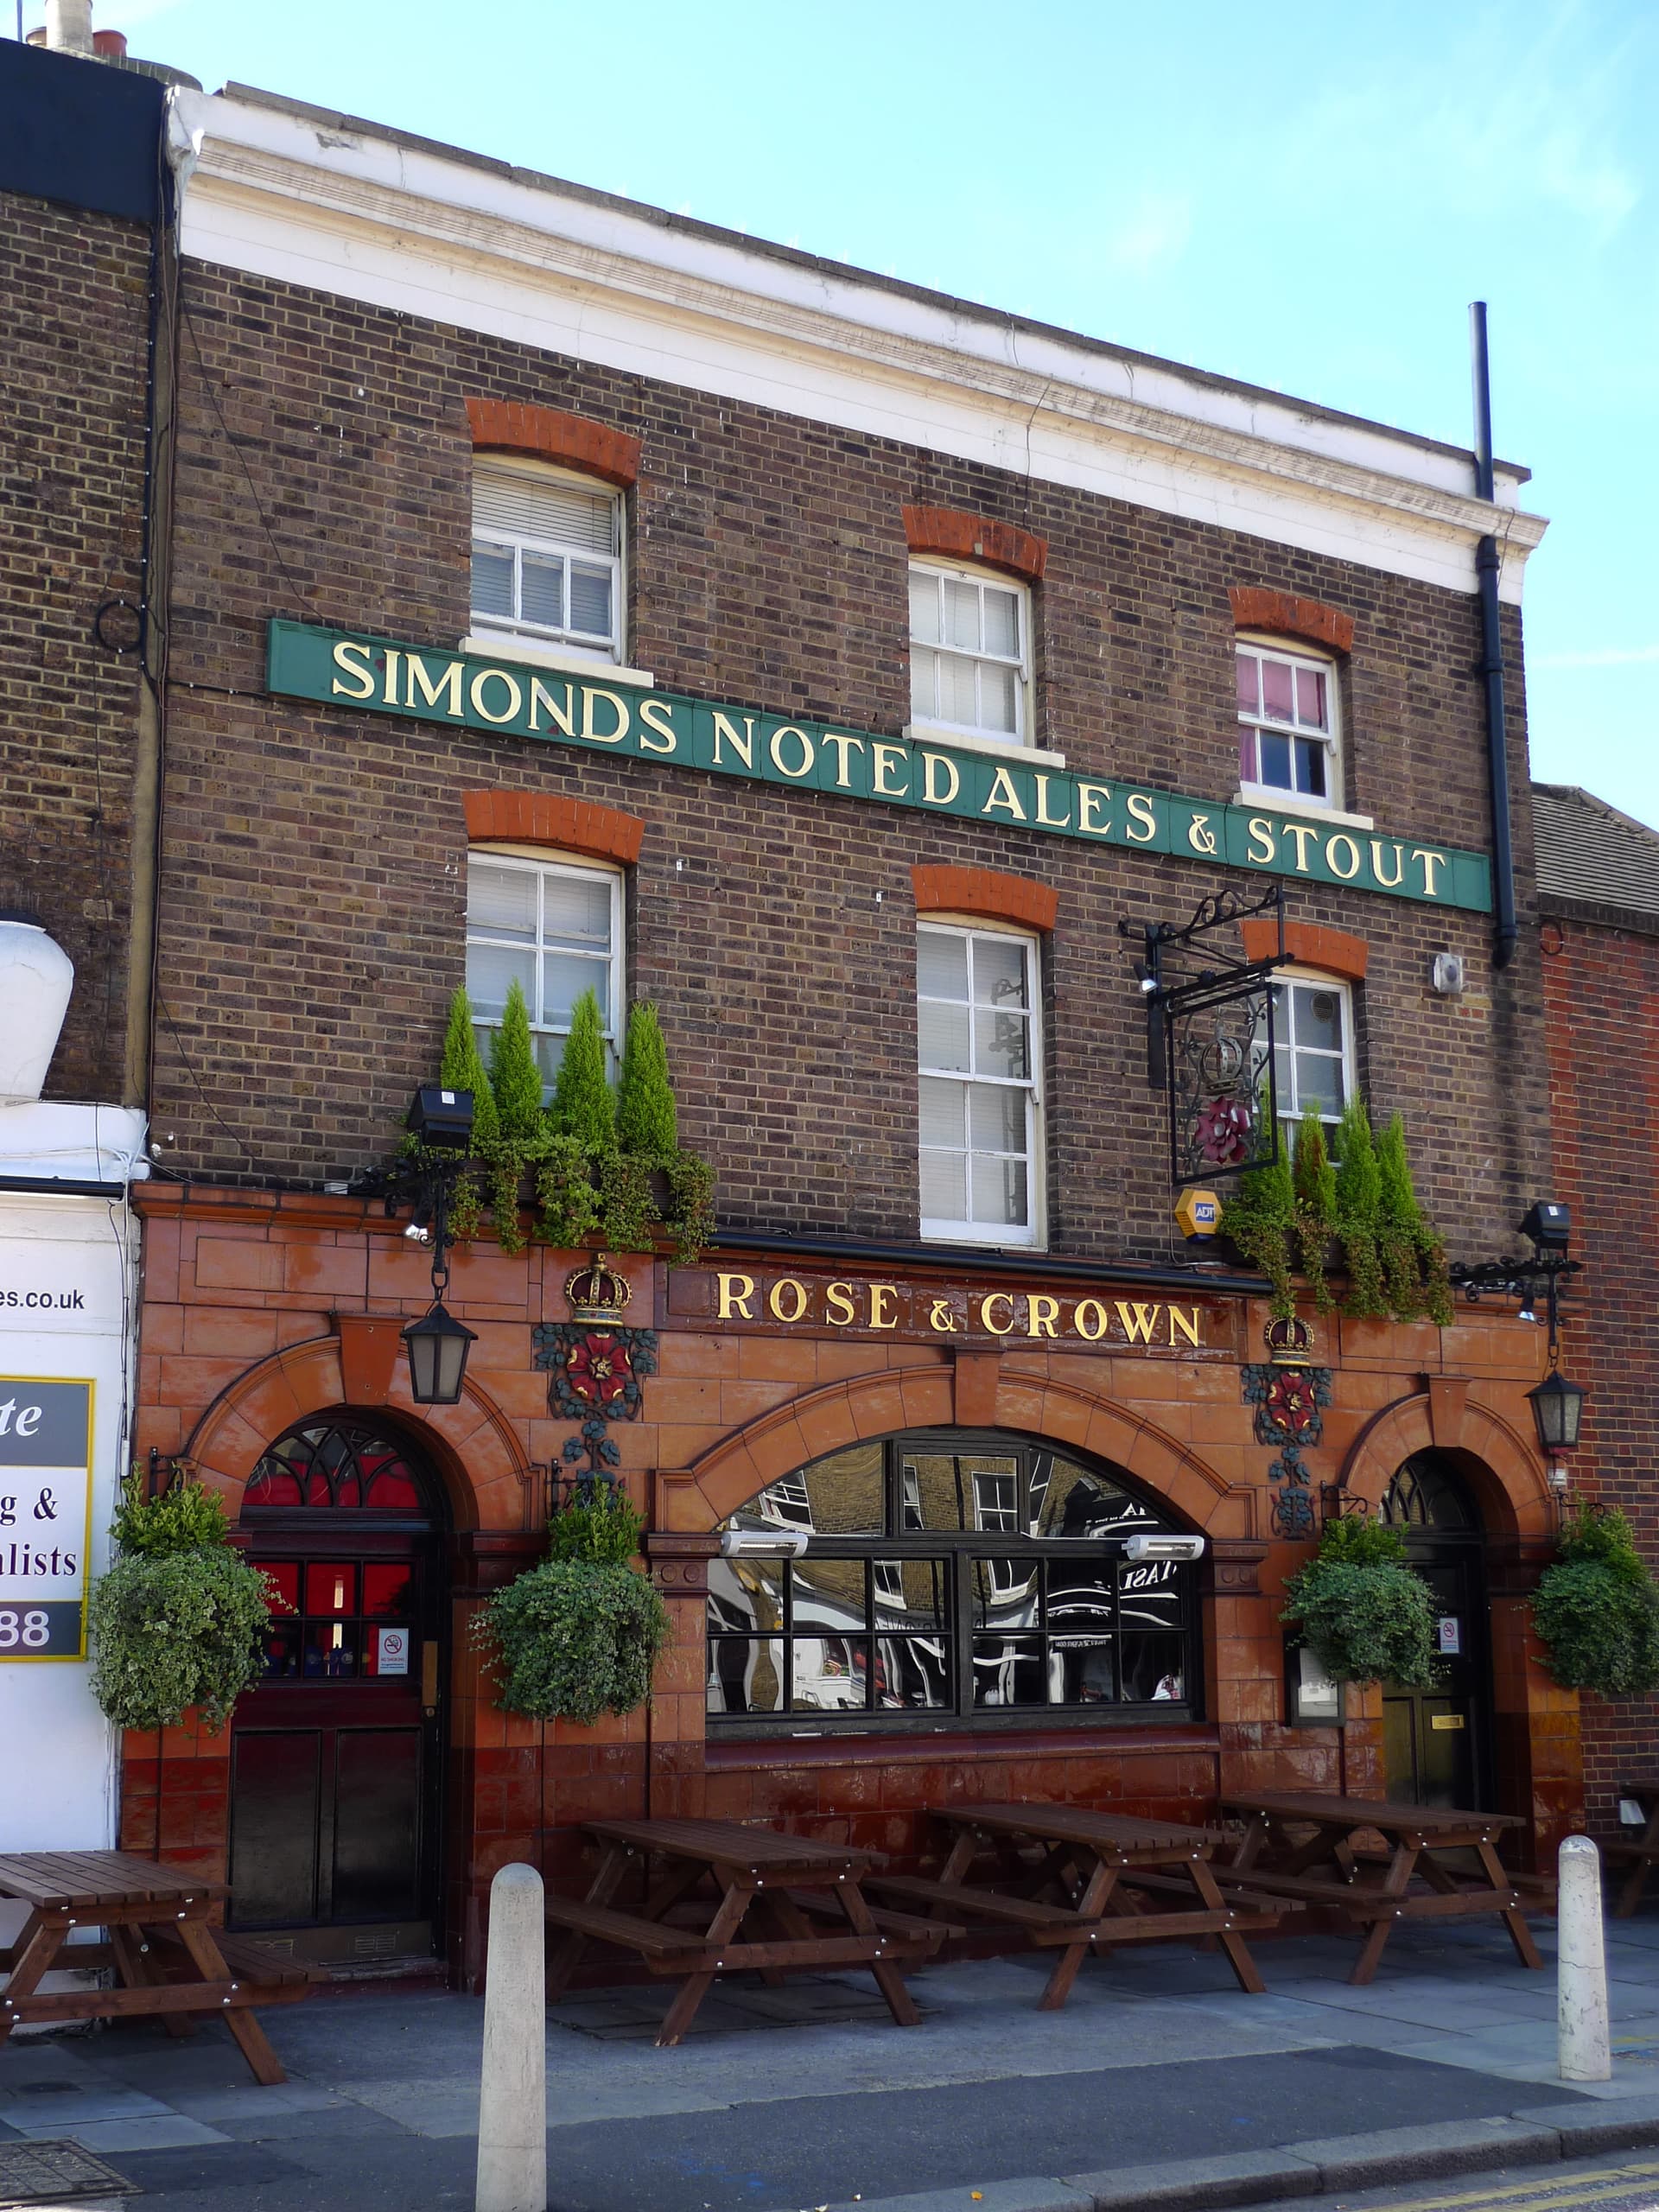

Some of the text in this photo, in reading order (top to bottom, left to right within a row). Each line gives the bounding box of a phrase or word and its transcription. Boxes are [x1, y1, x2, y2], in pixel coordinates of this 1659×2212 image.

[333, 641, 1446, 896] SIMONDS NOTED ALES & STOUT
[1195, 1206, 1216, 1218] ADT
[716, 1273, 1202, 1347] ROSE & CROWN
[33, 1487, 59, 1520] &
[0, 1610, 50, 1648] 88
